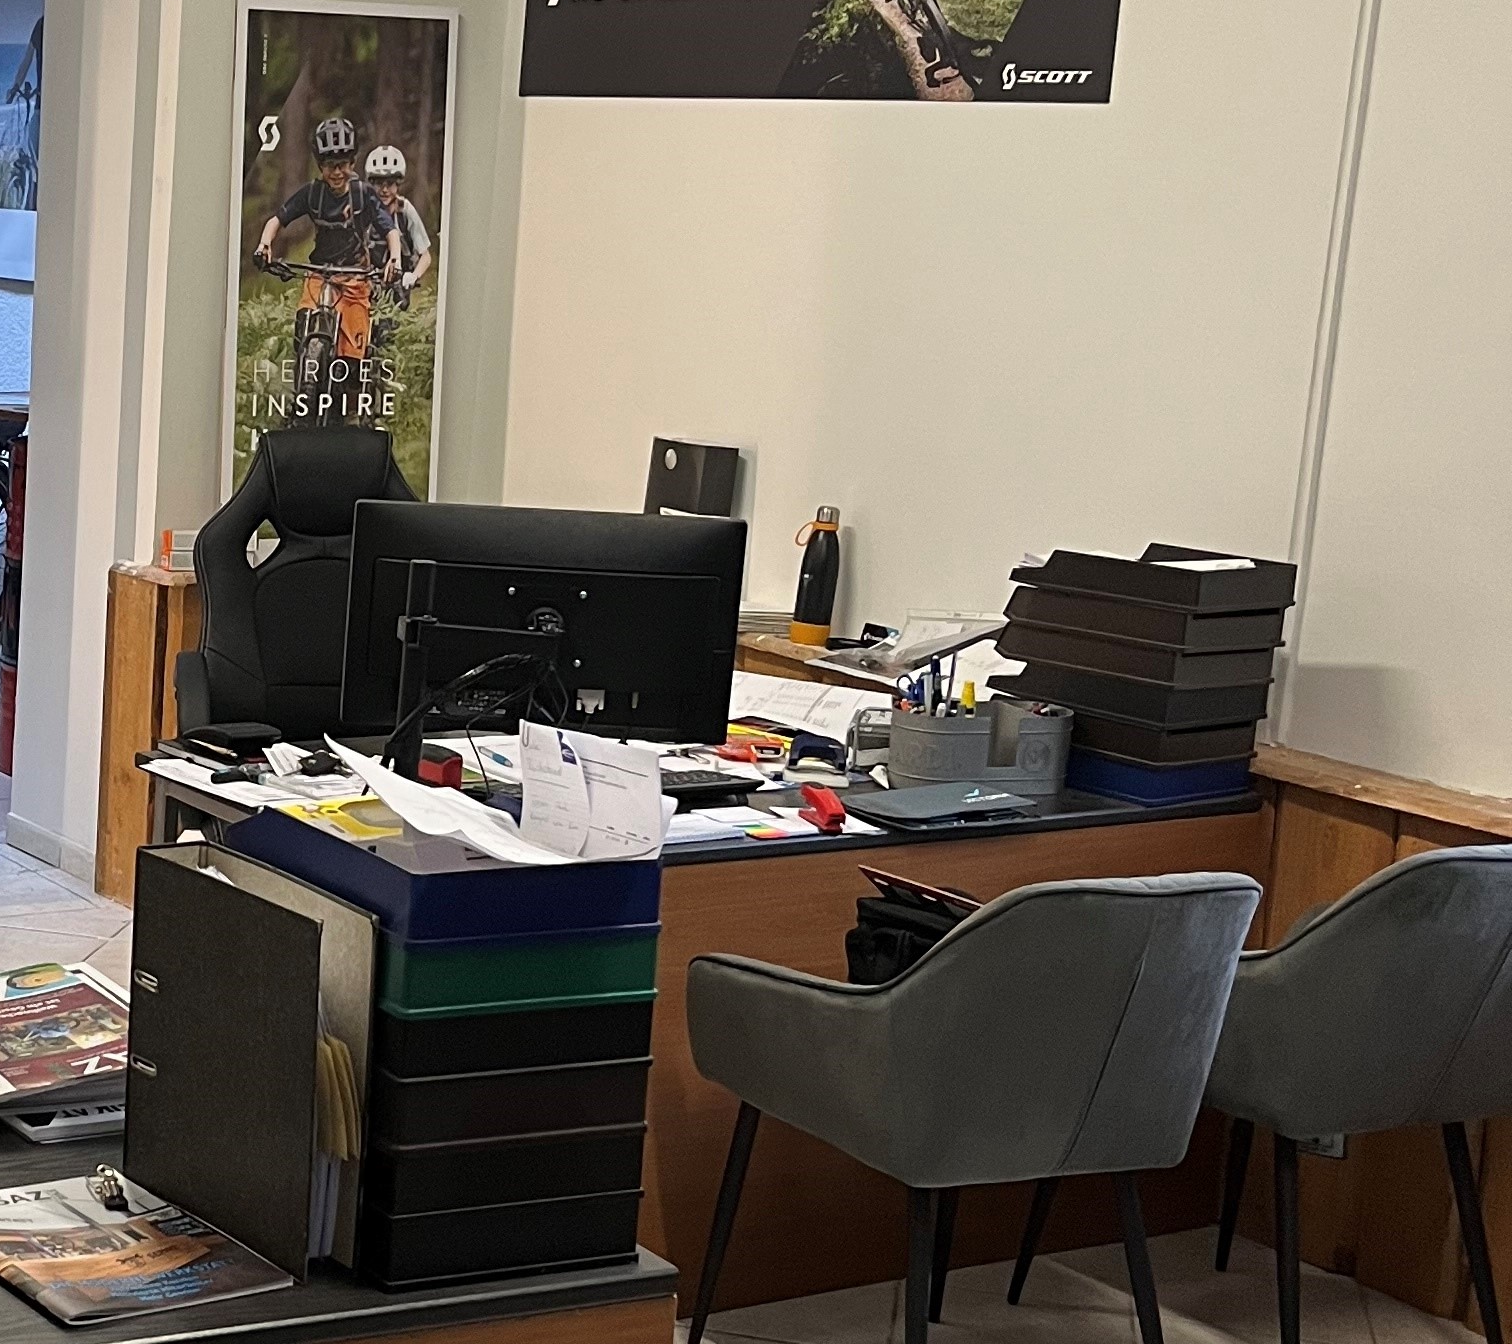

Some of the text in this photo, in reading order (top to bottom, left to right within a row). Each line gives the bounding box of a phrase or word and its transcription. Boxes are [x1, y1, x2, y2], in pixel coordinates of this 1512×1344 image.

[1017, 70, 1093, 84] SCOTT
[253, 359, 395, 383] HEROES
[252, 393, 396, 417] INSPIRE
